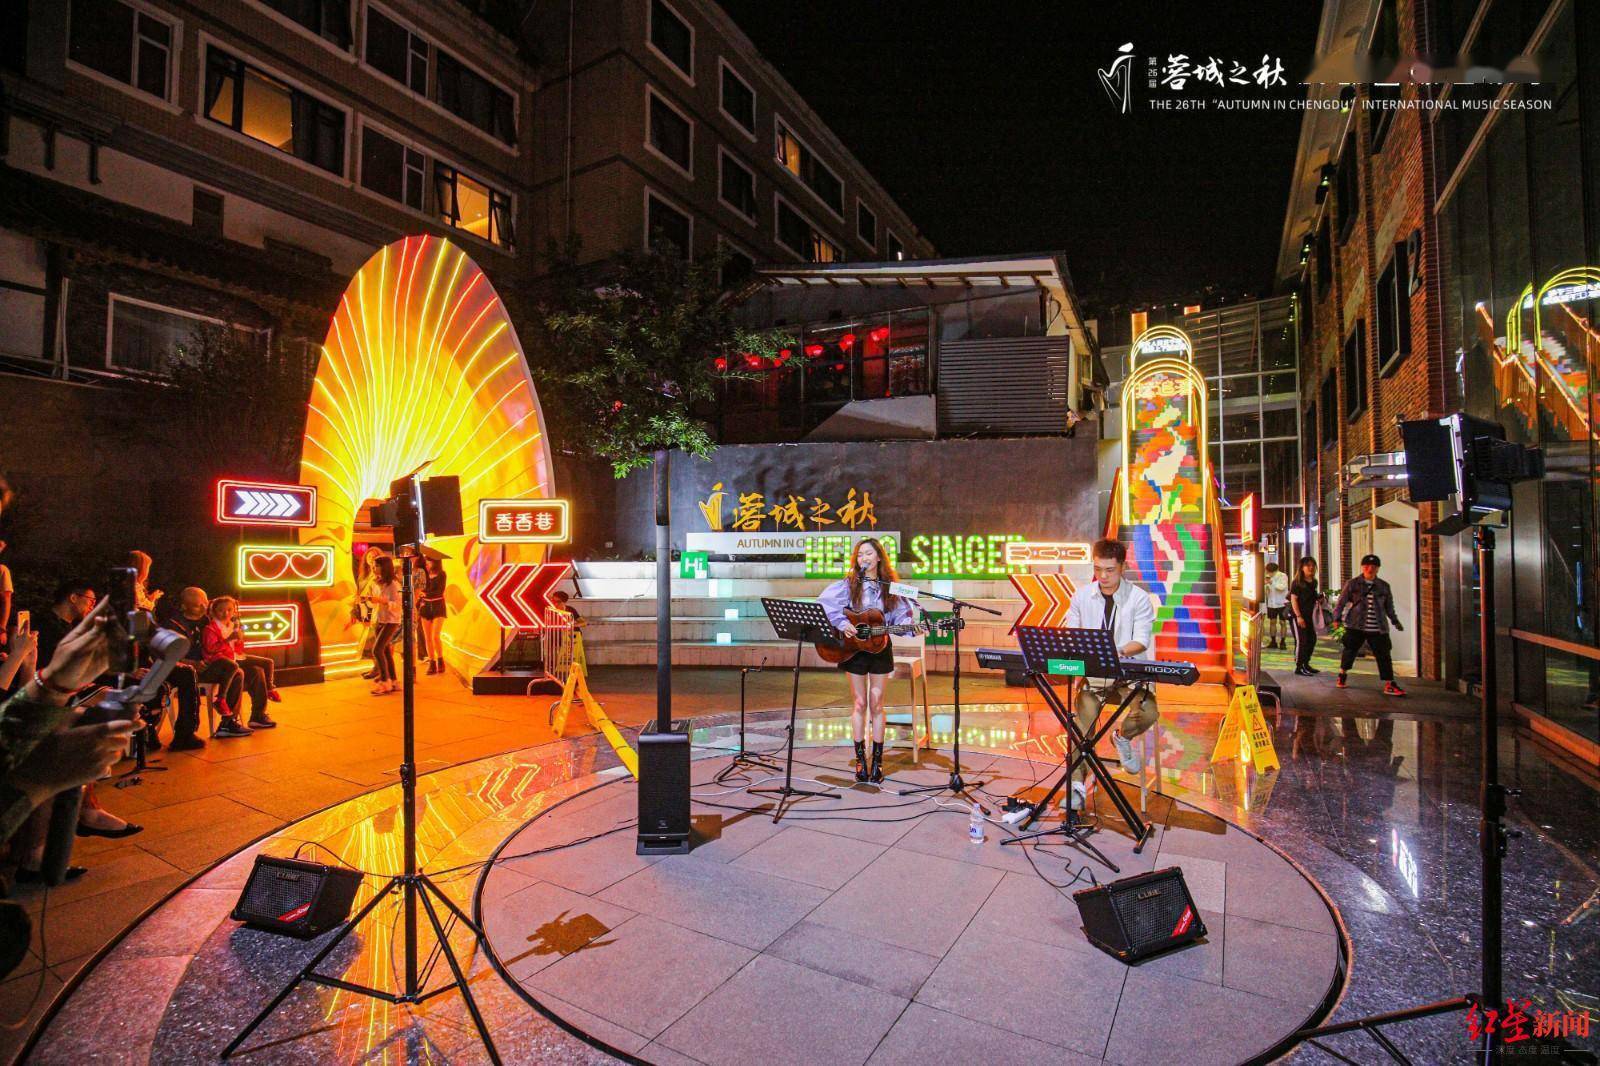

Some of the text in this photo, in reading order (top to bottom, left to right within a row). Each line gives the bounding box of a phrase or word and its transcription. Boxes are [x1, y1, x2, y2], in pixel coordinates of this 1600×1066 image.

[732, 488, 878, 531] 蓉城之秋
[495, 512, 554, 532] 香香巷
[736, 538, 782, 549] AUTUMN
[783, 538, 794, 549] IN
[684, 557, 704, 573] Hi
